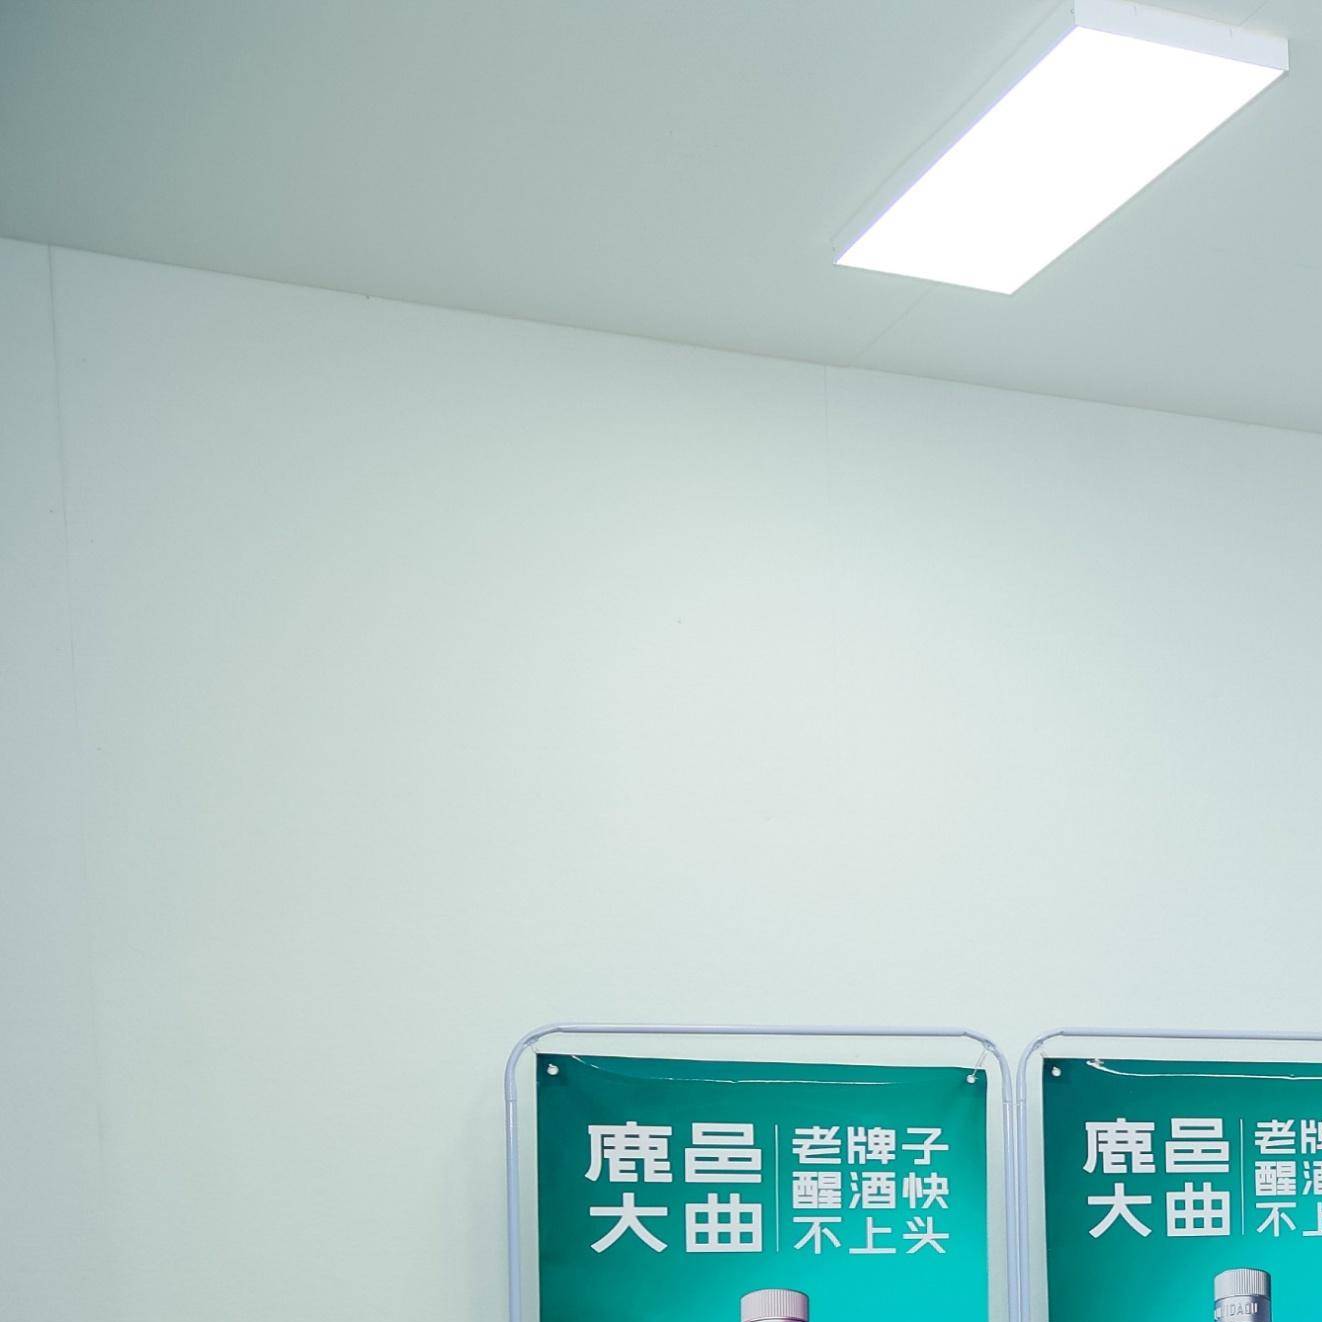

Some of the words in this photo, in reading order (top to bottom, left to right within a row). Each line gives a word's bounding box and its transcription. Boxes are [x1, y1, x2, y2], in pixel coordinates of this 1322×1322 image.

[586, 1121, 762, 1184] 鹿邑
[792, 1126, 949, 1165] 老牌子
[1083, 1118, 1230, 1174] 鹿邑
[792, 1171, 949, 1209] 醒酒快
[1087, 1182, 1231, 1239] 大曲
[589, 1192, 763, 1253] 大曲
[793, 1216, 949, 1254] 不上头
